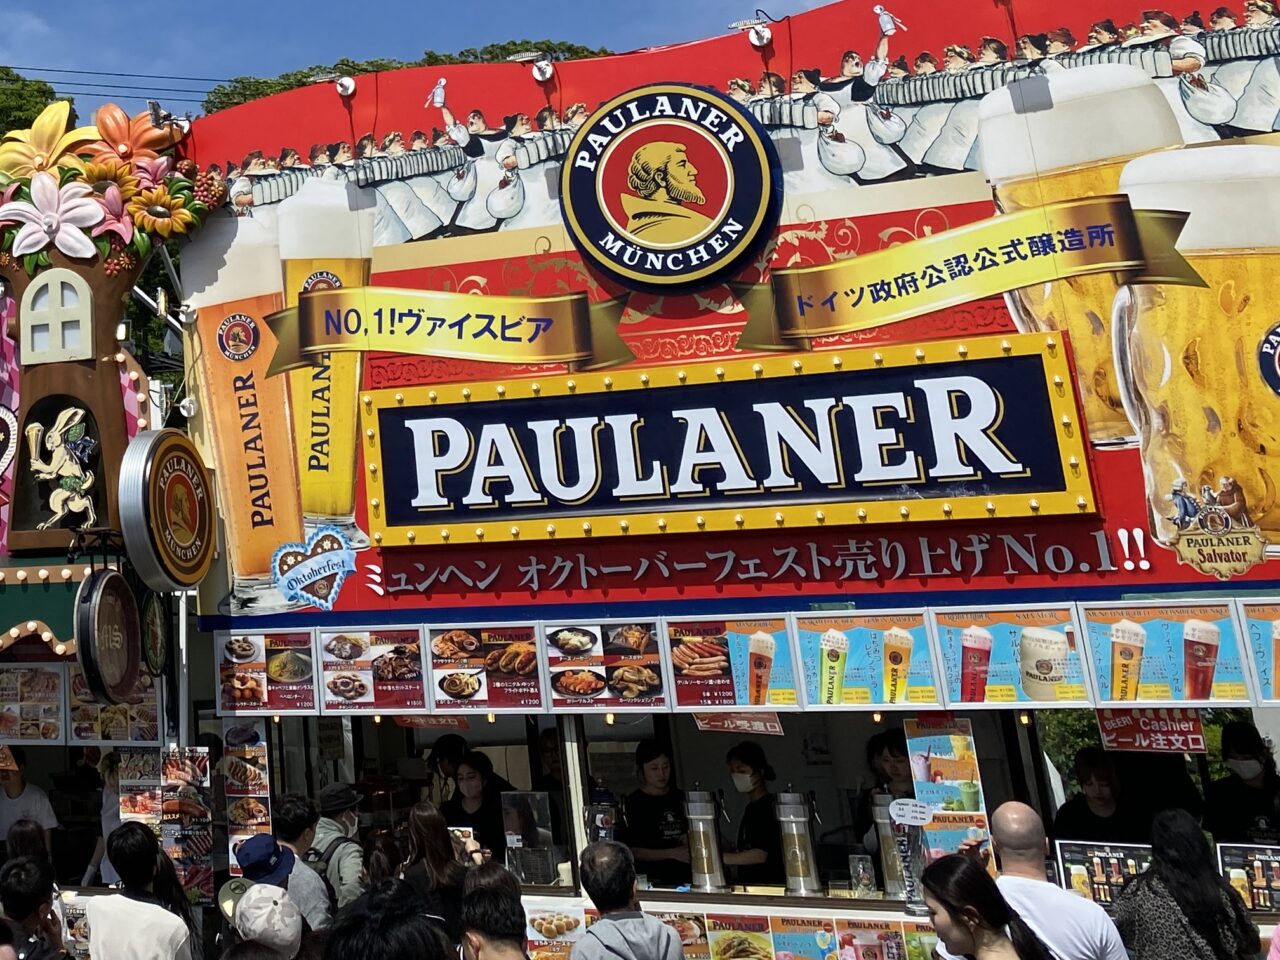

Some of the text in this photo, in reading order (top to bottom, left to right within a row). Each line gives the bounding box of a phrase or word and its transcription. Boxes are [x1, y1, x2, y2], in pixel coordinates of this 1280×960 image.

[574, 95, 744, 172] PAULANER
[598, 216, 743, 271] MÜNCHEN
[304, 272, 341, 289] PAULANER
[796, 222, 1116, 317] ドイツ政府公認公式醸造所
[218, 314, 256, 335] PAULANER
[225, 345, 256, 360] MÜNCHEN
[307, 352, 331, 473] PAULAN
[232, 369, 275, 530] PAULANER
[404, 374, 1023, 508] PAULANER
[158, 454, 204, 501] PAULANER
[163, 528, 202, 560] MÜNCHEN
[1186, 536, 1252, 548] PAULANER
[1198, 547, 1249, 564] Salvator
[287, 560, 345, 601] Oktoberfest
[364, 558, 502, 596] ミュンヘン
[99, 624, 124, 650] MS
[827, 665, 836, 704] PAULANER
[1025, 671, 1063, 682] PAULANER
[1139, 718, 1194, 732] Cashier
[1103, 732, 1205, 751] ビール注文口
[933, 814, 975, 823] PAULANER
[896, 838, 916, 904] PAULANER
[713, 921, 764, 931] PAULANER
[781, 918, 823, 928] PAULANER
[848, 921, 891, 930] PAULANER
